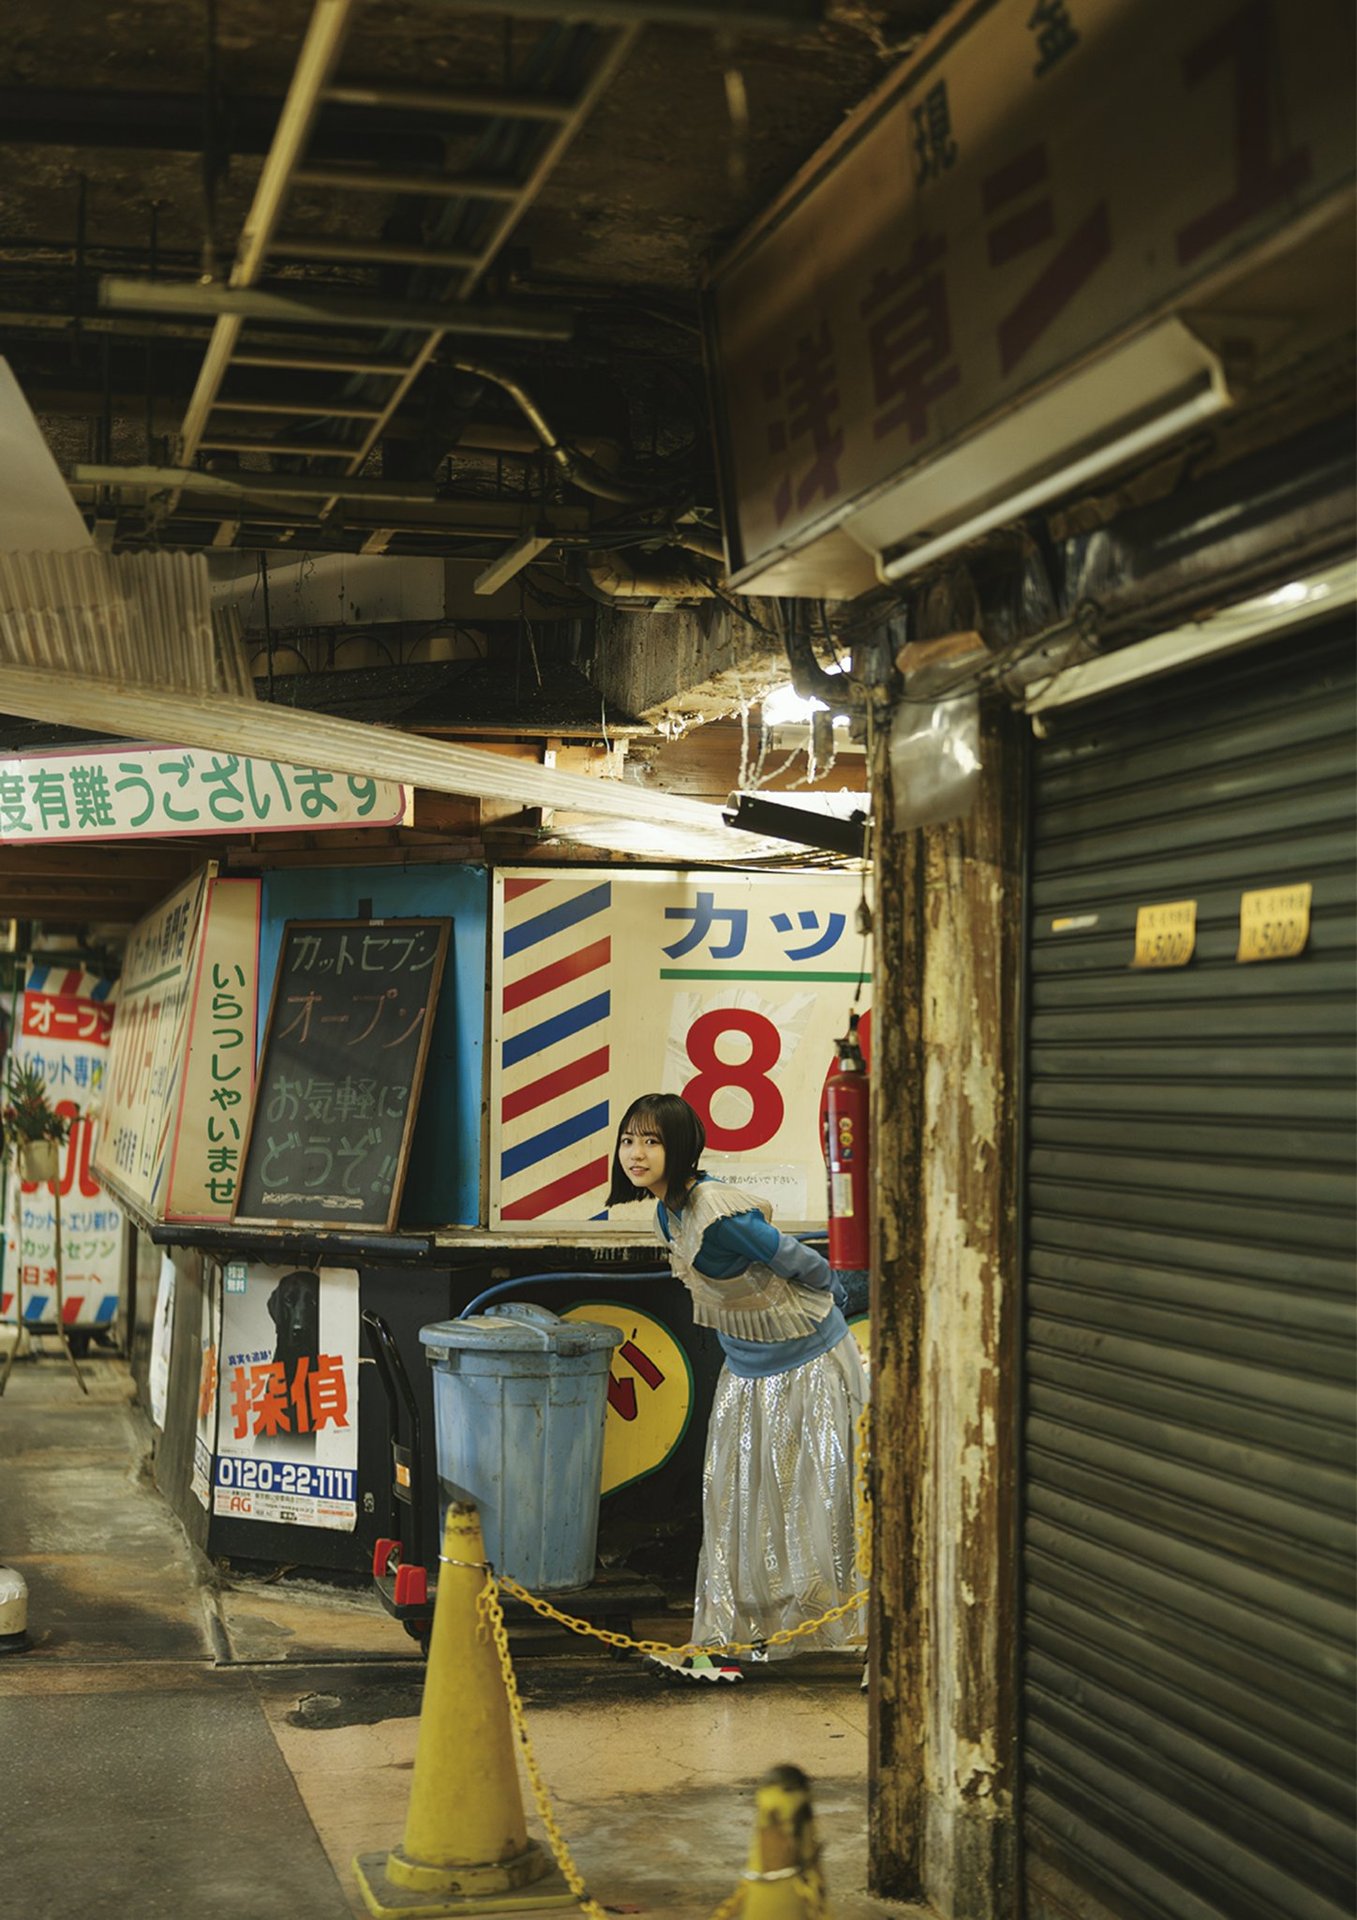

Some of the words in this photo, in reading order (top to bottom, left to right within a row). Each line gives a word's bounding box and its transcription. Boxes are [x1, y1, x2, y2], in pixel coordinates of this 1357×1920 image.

[661, 891, 846, 961] カッ
[291, 930, 438, 975] カットセブン
[277, 988, 427, 1049] オープン
[266, 1075, 408, 1123] お気軽に
[229, 1354, 350, 1440] 探偵
[218, 1457, 353, 1500] 0120-22-1111
[230, 1495, 252, 1513] AG
